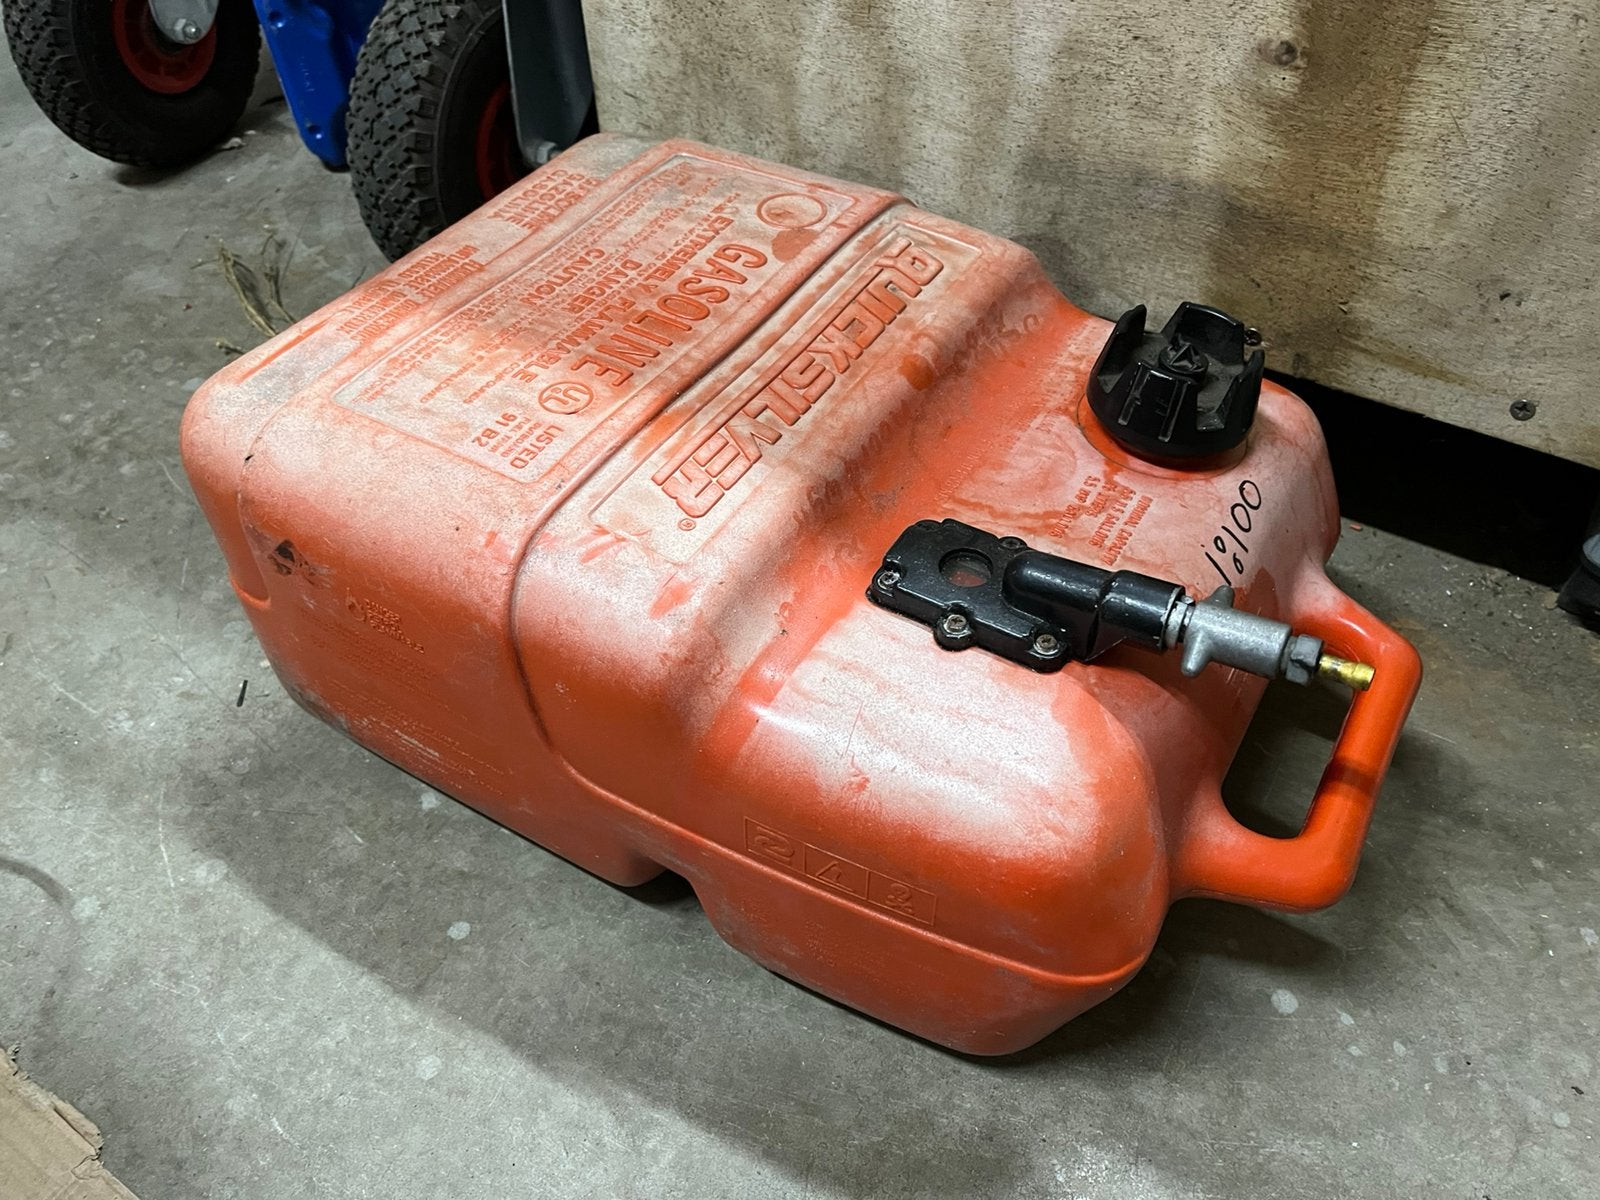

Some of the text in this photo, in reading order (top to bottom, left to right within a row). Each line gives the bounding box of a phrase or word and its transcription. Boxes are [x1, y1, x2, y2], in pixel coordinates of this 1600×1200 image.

[519, 248, 606, 308] CAUTION
[574, 259, 643, 312] DANGER
[636, 214, 732, 292] EXTREMELY
[511, 293, 636, 384] FLAMMABLE
[570, 243, 768, 388] GASOLINE
[651, 239, 944, 518] QUICKSILVER
[472, 412, 513, 447] 91 B2
[510, 425, 564, 469] LISTED
